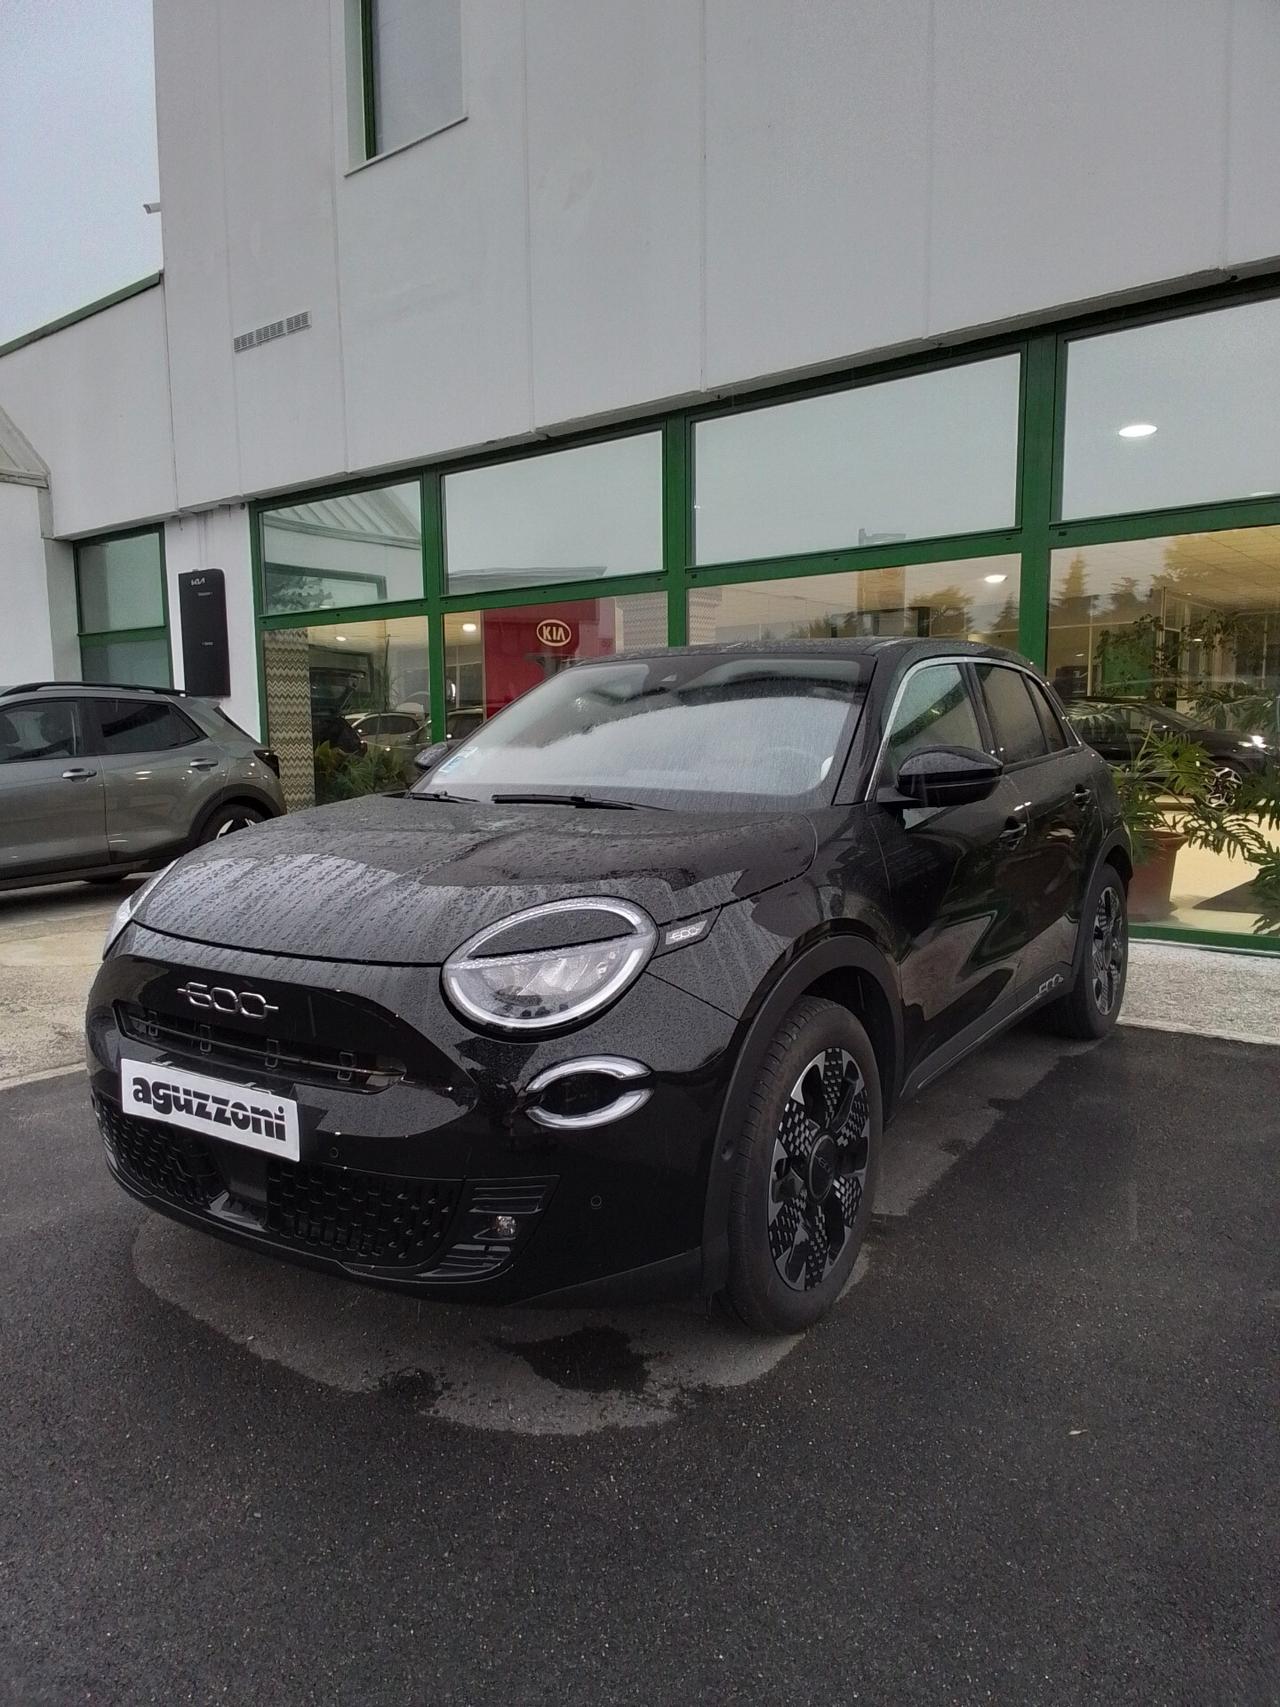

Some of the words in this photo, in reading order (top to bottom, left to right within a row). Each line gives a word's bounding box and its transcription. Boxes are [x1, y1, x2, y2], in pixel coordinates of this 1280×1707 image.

[542, 625, 566, 641] KIA
[177, 981, 279, 1019] 600
[132, 1077, 287, 1142] aguzzoni
